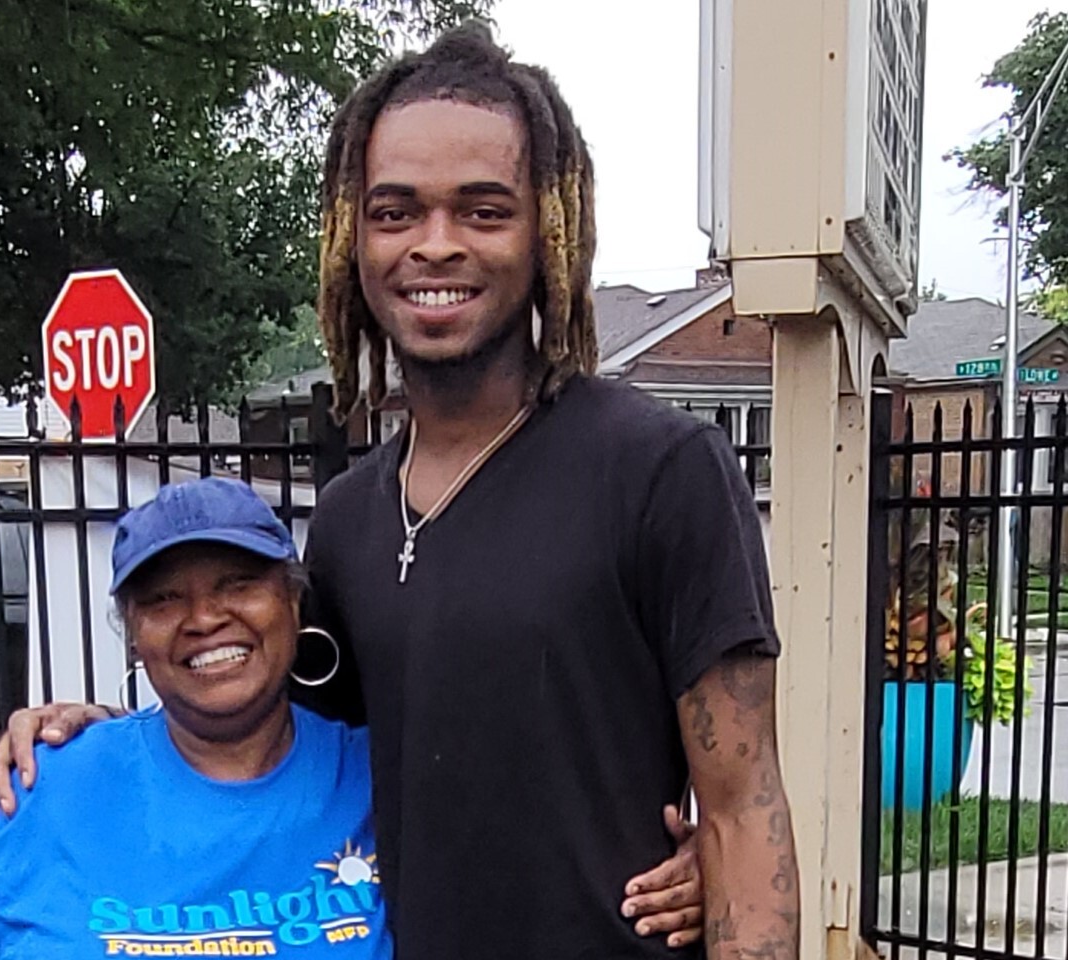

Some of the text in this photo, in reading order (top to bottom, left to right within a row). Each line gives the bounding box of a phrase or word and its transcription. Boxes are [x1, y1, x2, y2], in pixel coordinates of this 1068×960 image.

[52, 325, 145, 392] STOP
[88, 874, 378, 946] Sunlight
[106, 936, 278, 957] Foundation
